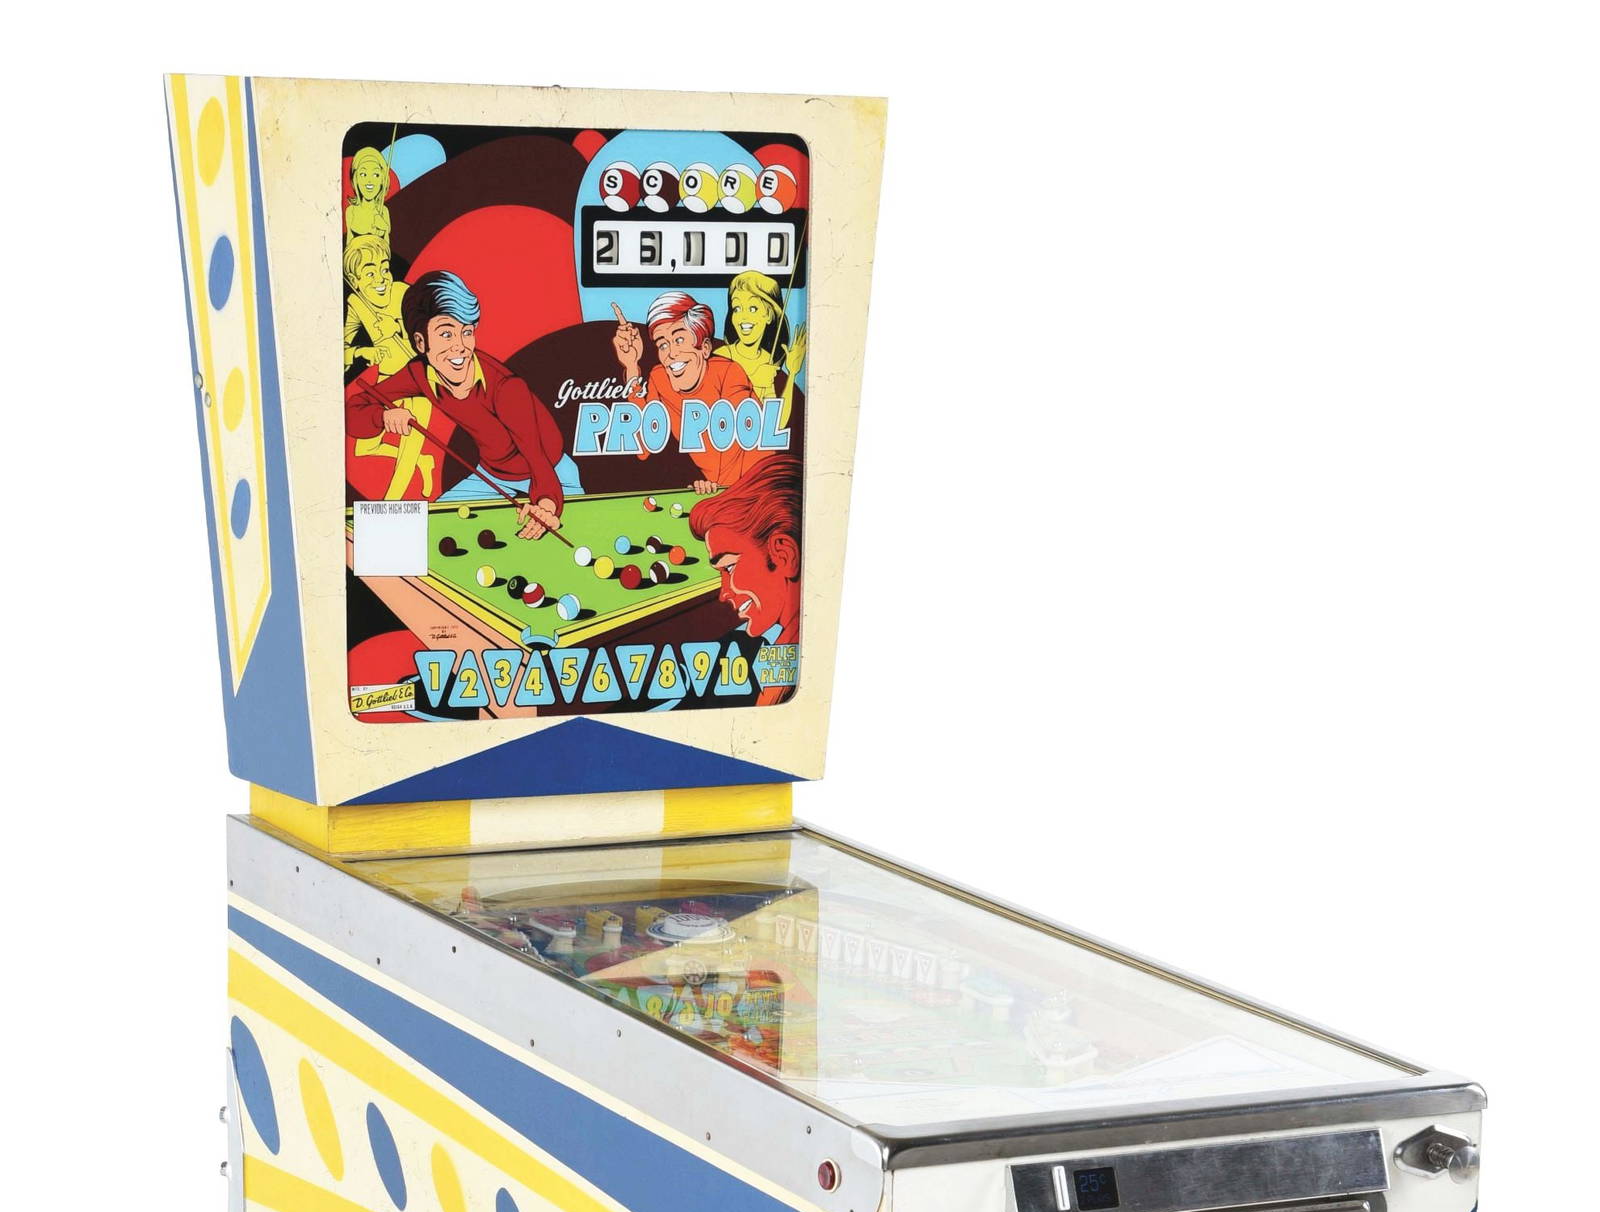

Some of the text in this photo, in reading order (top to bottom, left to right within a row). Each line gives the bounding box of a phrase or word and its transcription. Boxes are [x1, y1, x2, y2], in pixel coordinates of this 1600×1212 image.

[605, 174, 775, 190] SCORE
[554, 376, 649, 409] Gottlieb's
[573, 397, 791, 456] PRO POOL
[360, 503, 421, 515] PREVIOUS HIGH SCORE
[759, 645, 797, 662] BALLS
[429, 651, 749, 699] 1 2 3 4 5 6 7 8 9 10
[760, 667, 797, 684] PLAY
